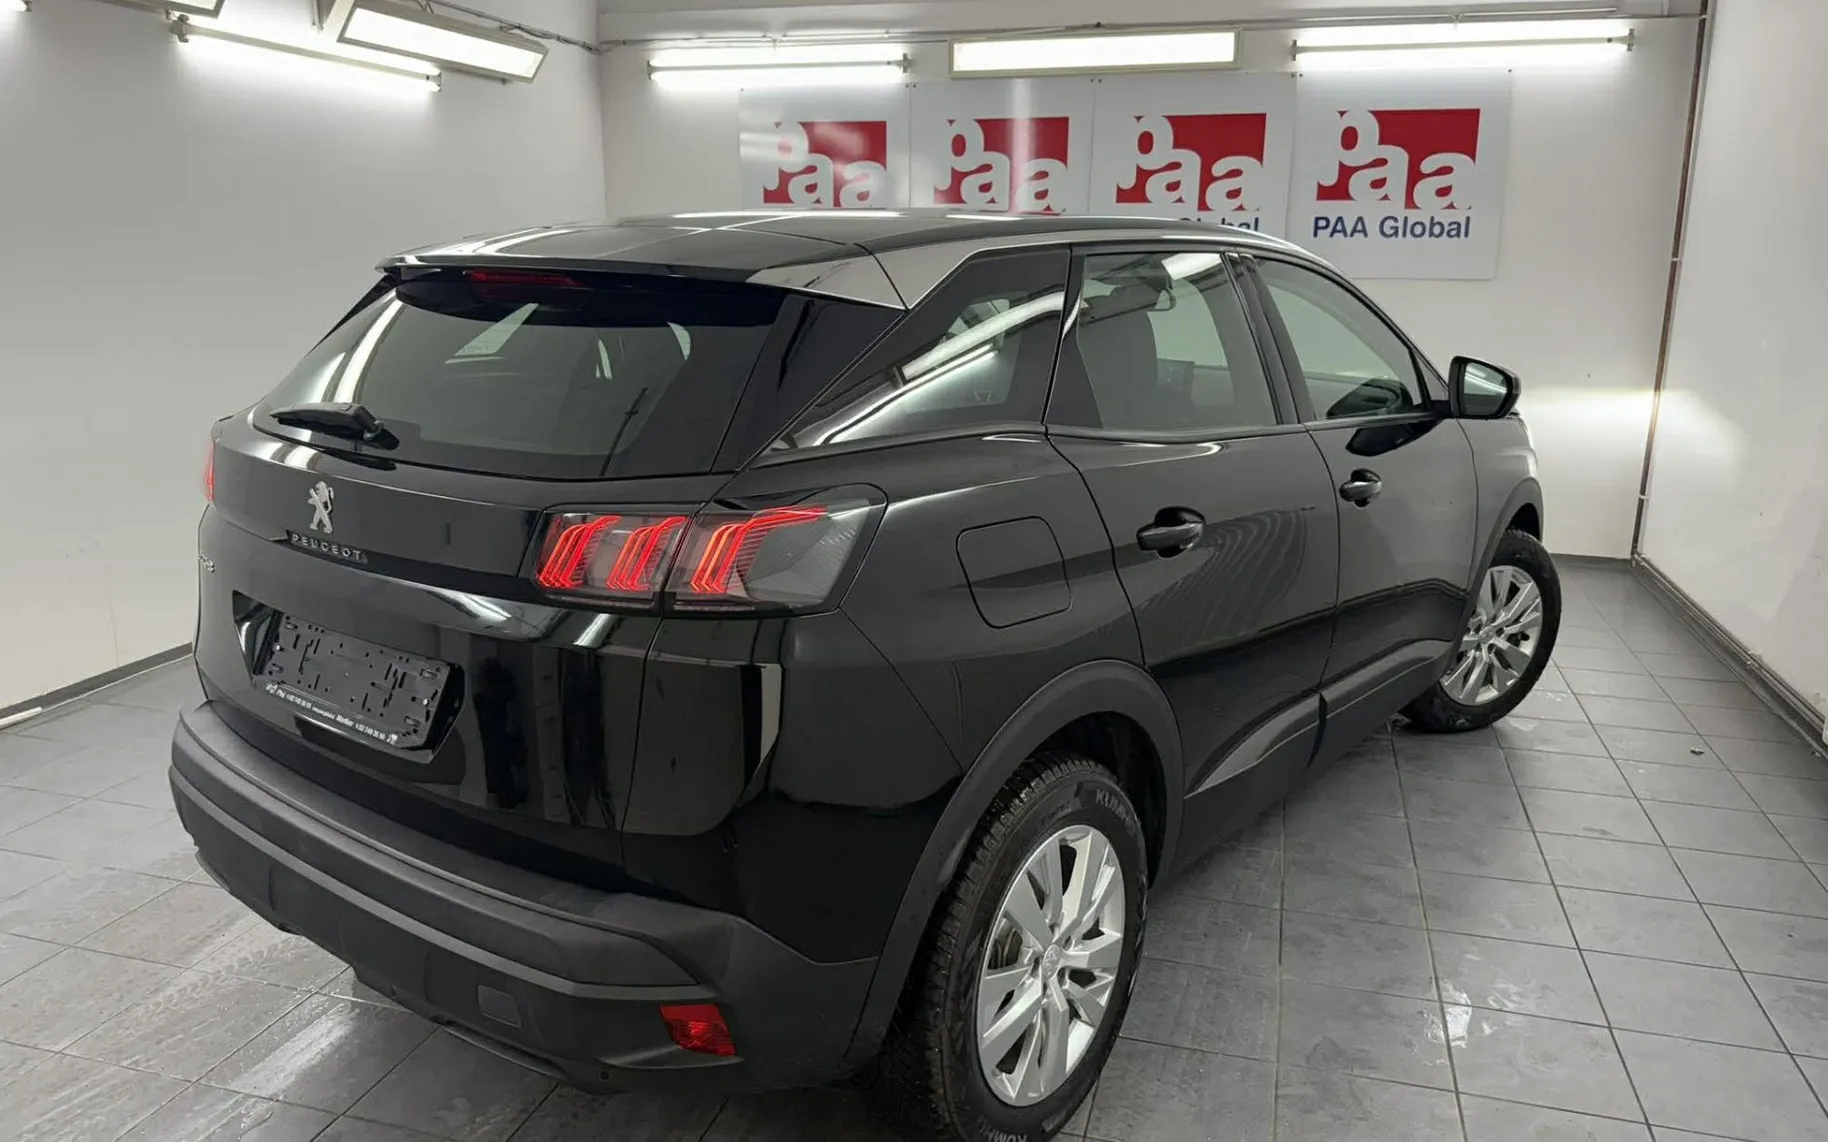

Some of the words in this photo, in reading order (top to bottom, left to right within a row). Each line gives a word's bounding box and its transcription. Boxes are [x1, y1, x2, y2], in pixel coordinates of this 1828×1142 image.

[1313, 216, 1369, 238] PAA
[1379, 215, 1471, 238] Global
[291, 533, 362, 560] PEUGEOT
